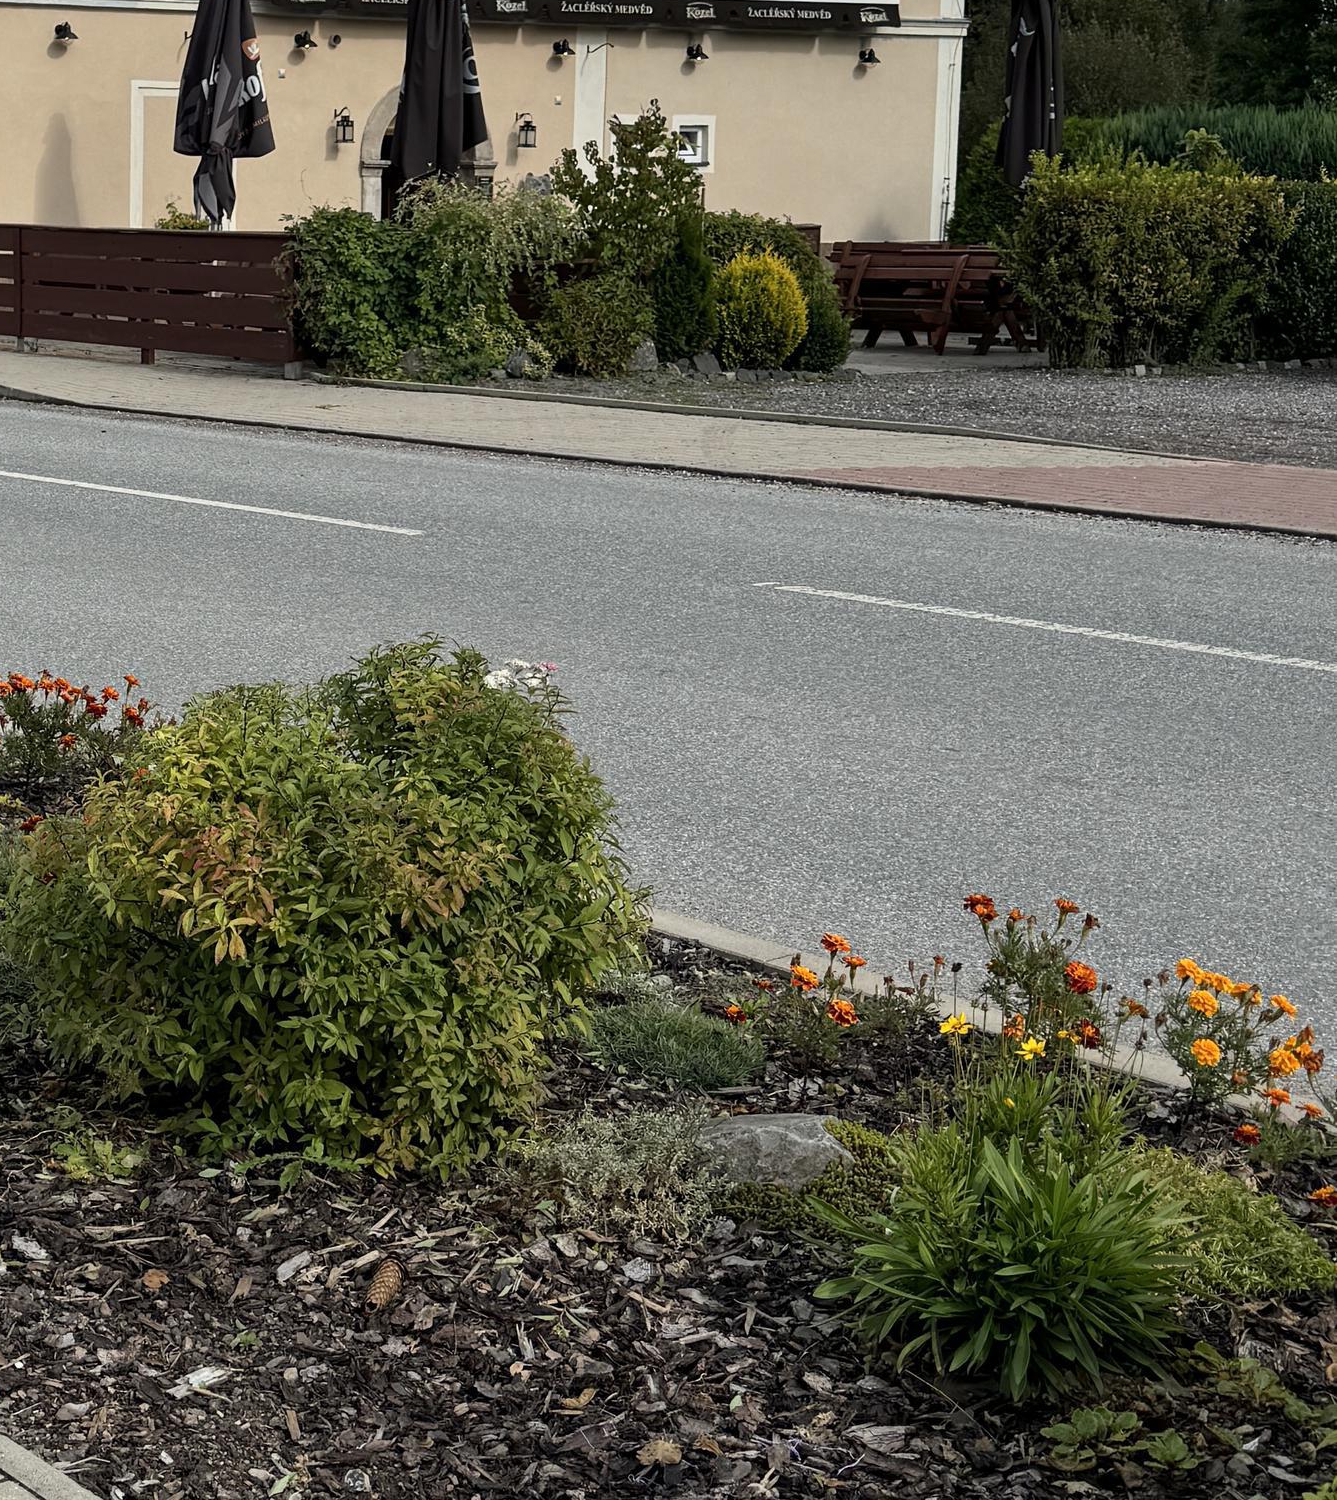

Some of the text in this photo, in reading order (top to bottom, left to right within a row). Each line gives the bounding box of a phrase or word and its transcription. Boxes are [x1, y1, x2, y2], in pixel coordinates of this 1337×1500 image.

[496, 0, 528, 12] Kozel
[561, 1, 653, 15] ŽACLÉŘSKÝ MEDVĚD
[686, 6, 716, 19] Kozel
[797, 7, 832, 19] MEDVĚD
